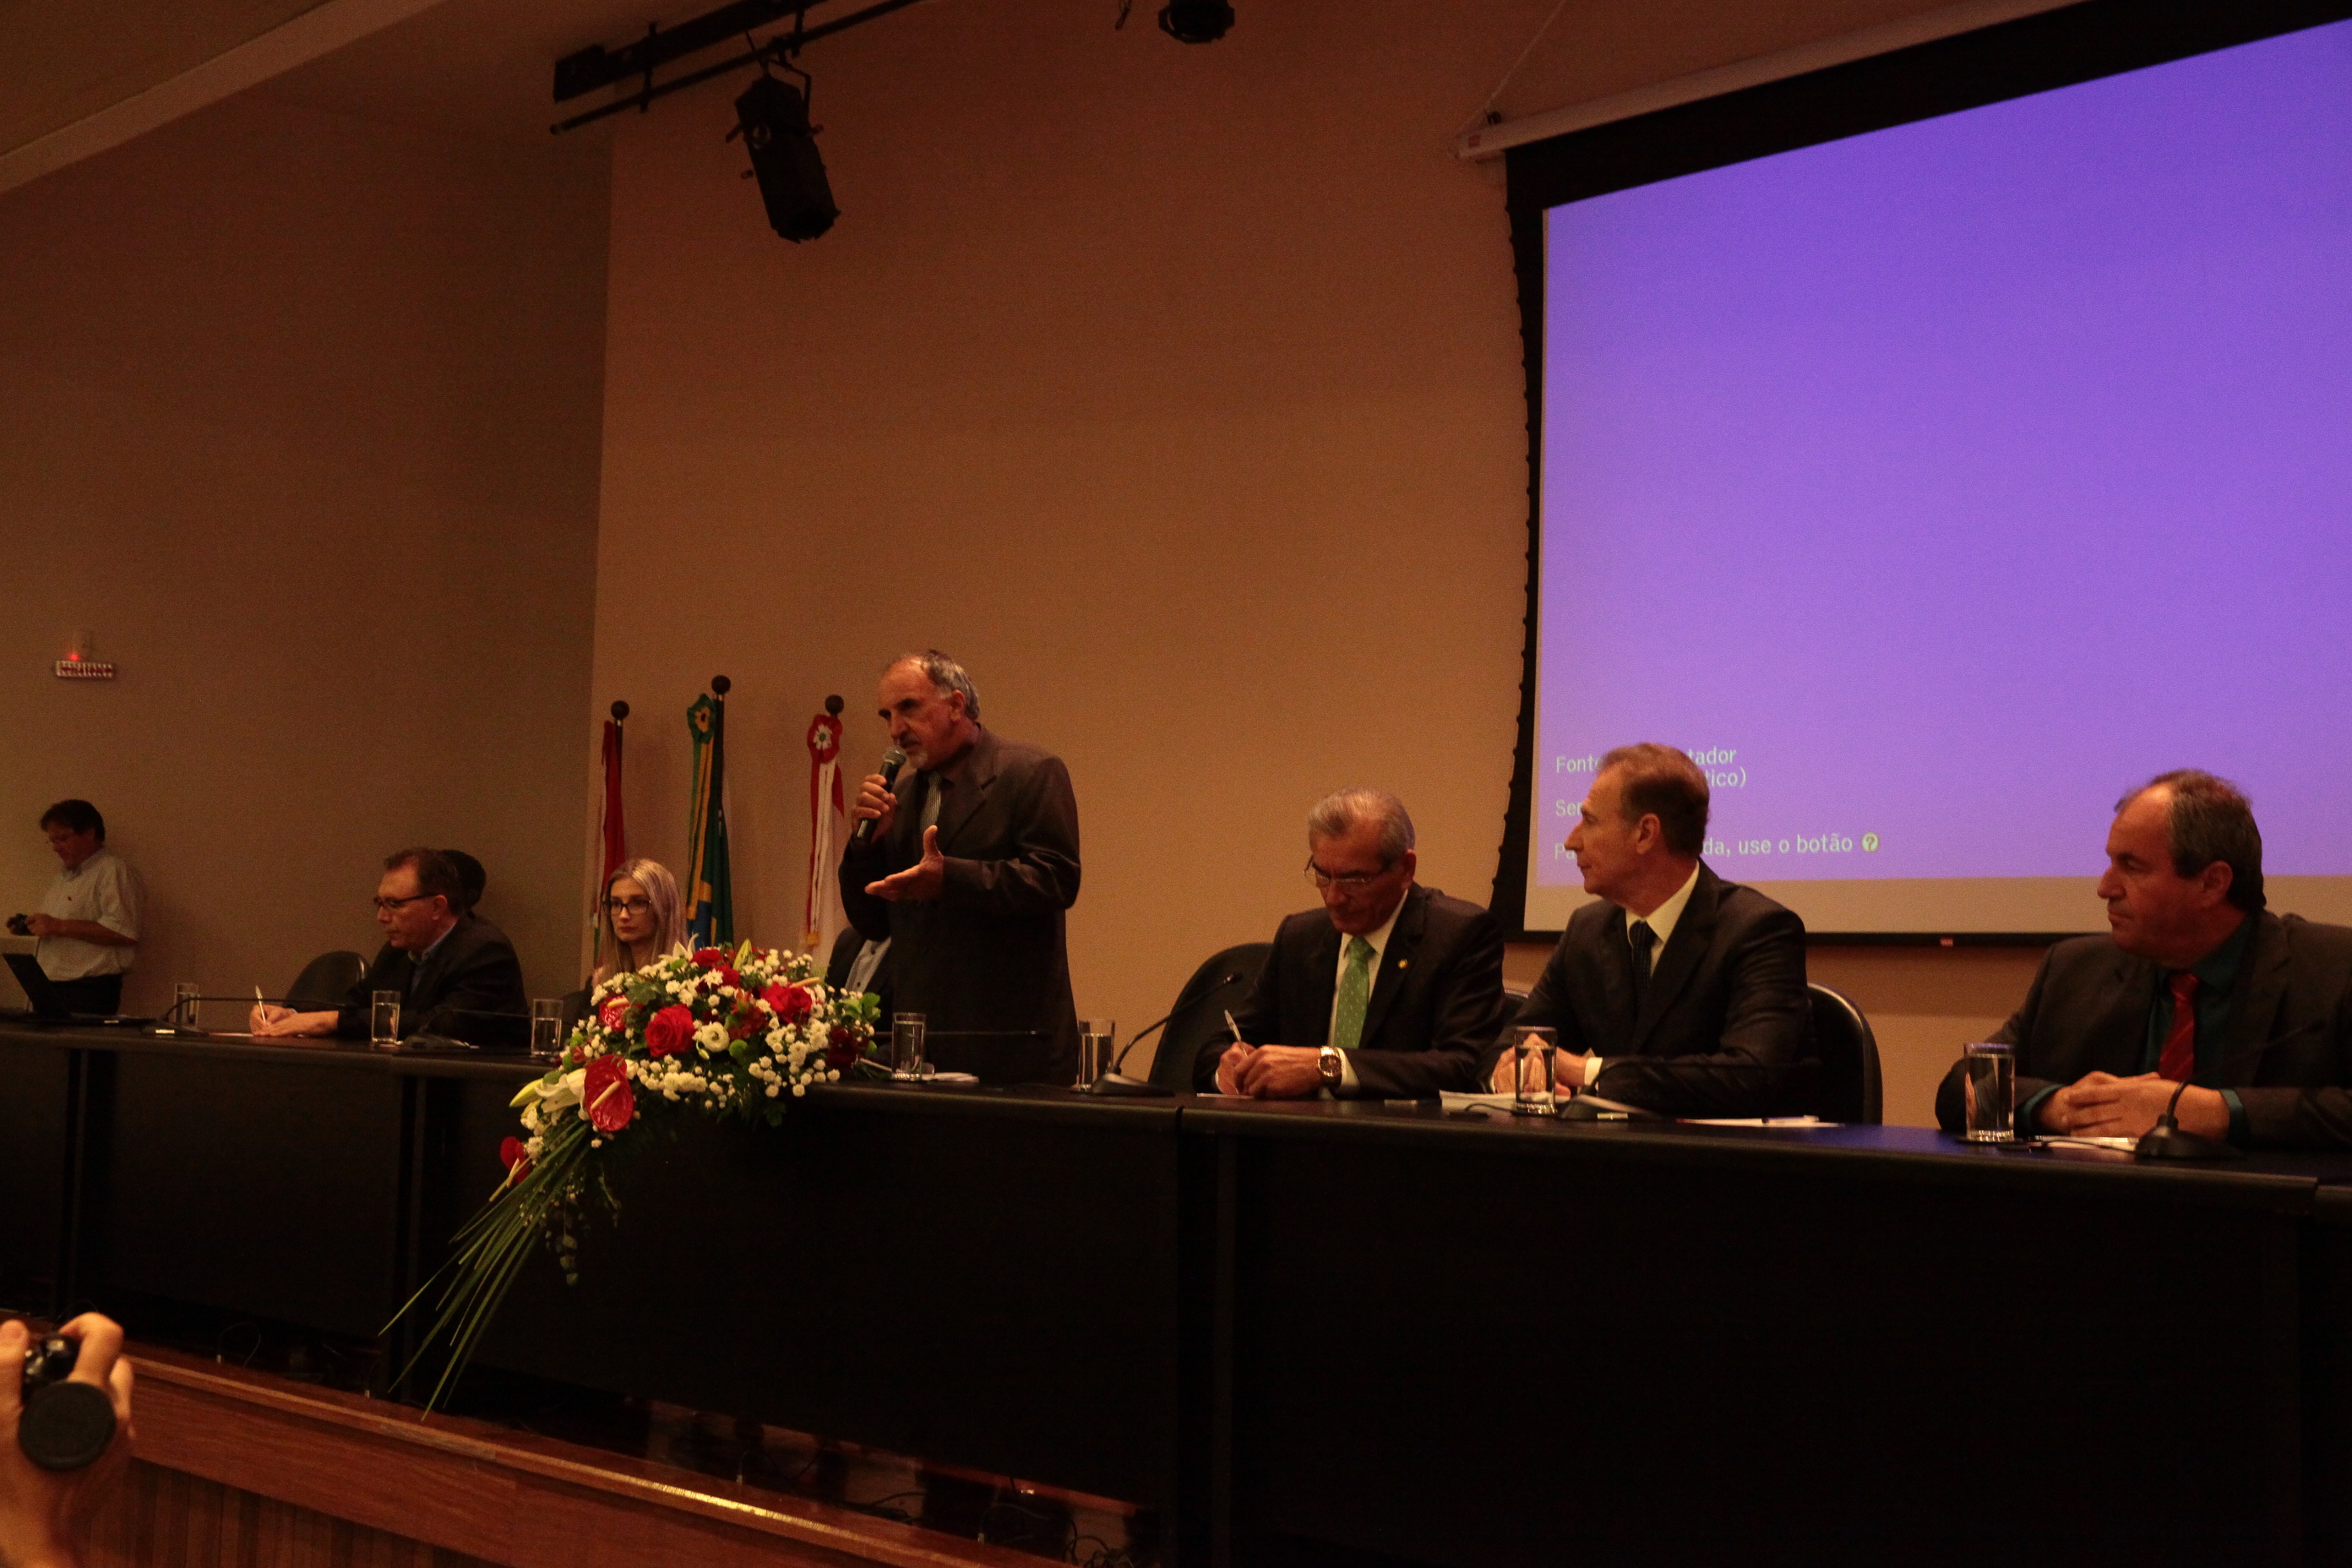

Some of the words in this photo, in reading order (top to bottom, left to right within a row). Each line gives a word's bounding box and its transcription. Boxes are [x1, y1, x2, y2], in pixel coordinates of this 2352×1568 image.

[1687, 745, 1737, 765] tador
[1706, 766, 1747, 787] tico)
[1554, 843, 1577, 860] Pa
[1702, 837, 1731, 857] da,
[1738, 839, 1772, 855] use
[1778, 839, 1790, 854] o
[1796, 833, 1853, 853] botão
